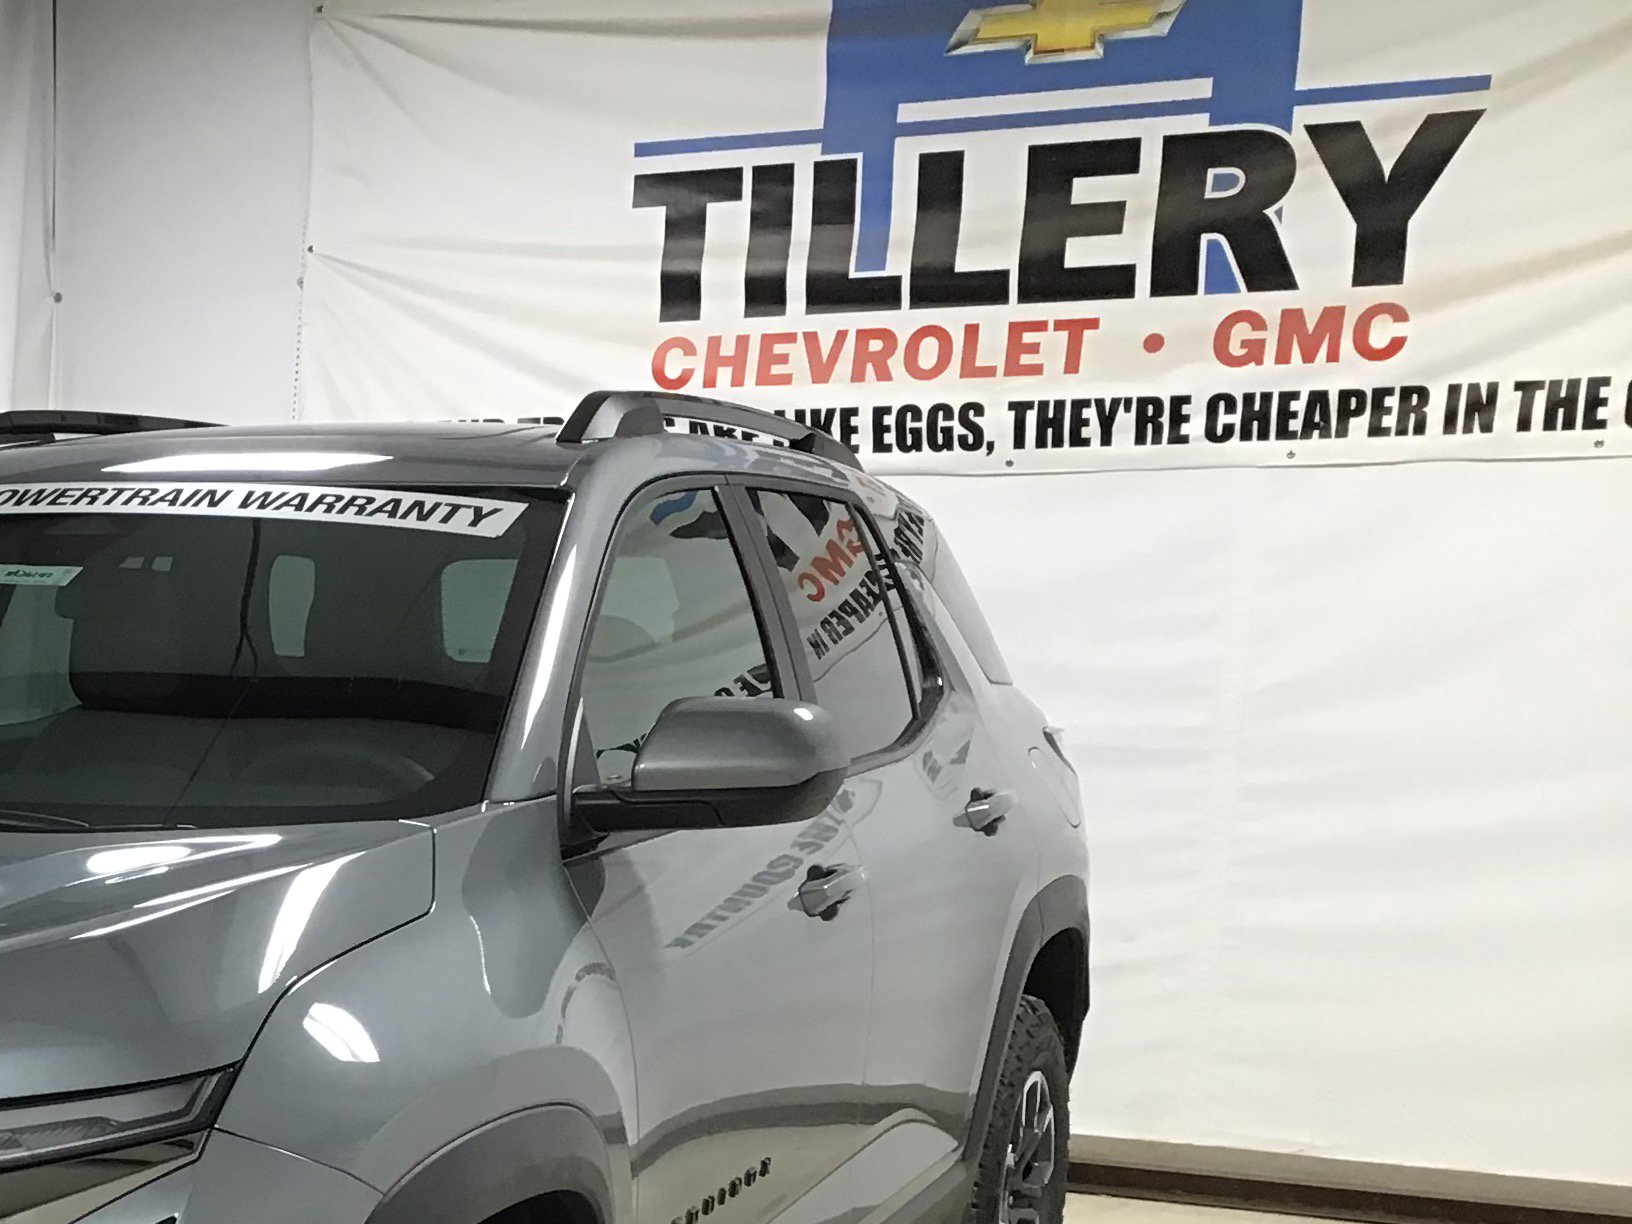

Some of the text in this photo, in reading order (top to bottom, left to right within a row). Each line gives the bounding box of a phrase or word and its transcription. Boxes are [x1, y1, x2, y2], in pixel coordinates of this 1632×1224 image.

[633, 109, 1487, 322] TILLERY
[651, 302, 1410, 391] CHEVROLET GMC
[774, 405, 860, 454] KE
[872, 401, 995, 457] EGGS,
[1008, 394, 1192, 450] THEY'RE
[1204, 384, 1431, 443] CHEAPER
[1442, 381, 1500, 435] IN
[1514, 376, 1612, 432] THE
[239, 490, 504, 528] WARRANTY
